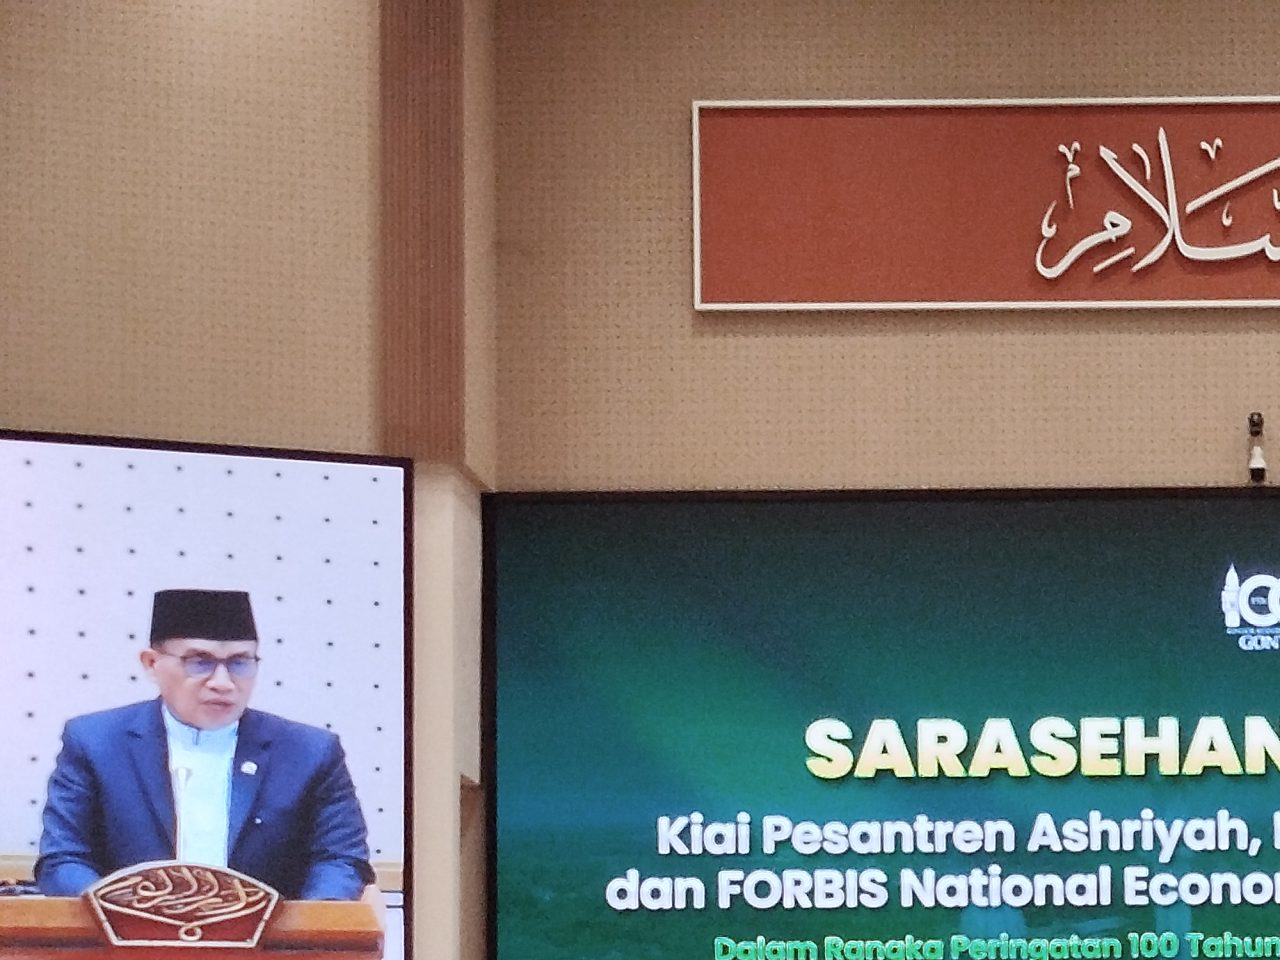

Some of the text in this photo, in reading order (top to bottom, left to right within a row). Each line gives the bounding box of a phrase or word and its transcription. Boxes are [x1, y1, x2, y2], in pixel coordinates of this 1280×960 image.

[657, 811, 751, 855] Kiai
[762, 813, 1016, 855] Pesantren
[1027, 807, 1262, 864] Ashriyah,
[605, 868, 706, 911] dan
[717, 868, 889, 909] FORBIS
[900, 863, 1112, 908] National
[1127, 930, 1180, 959] 100
